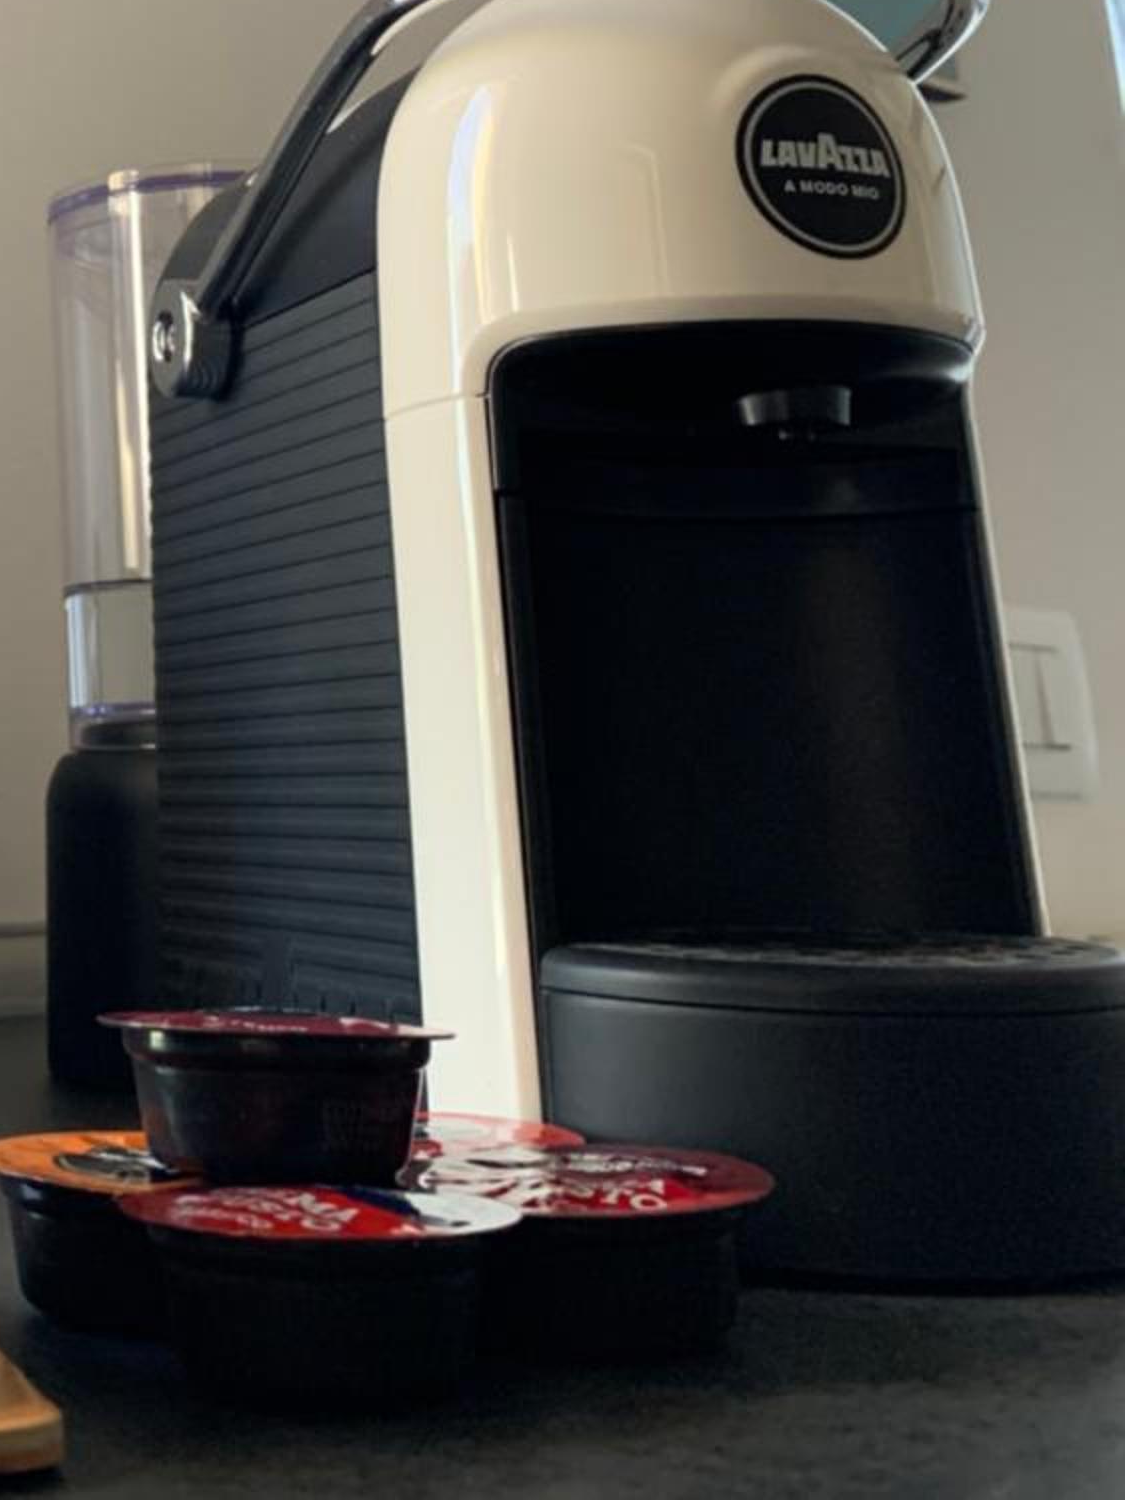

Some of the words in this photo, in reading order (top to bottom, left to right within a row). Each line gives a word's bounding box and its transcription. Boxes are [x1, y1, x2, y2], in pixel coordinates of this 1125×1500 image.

[760, 131, 892, 179] LAVAZZA
[784, 180, 796, 193] A
[800, 180, 849, 196] MODO
[851, 185, 880, 200] MIO
